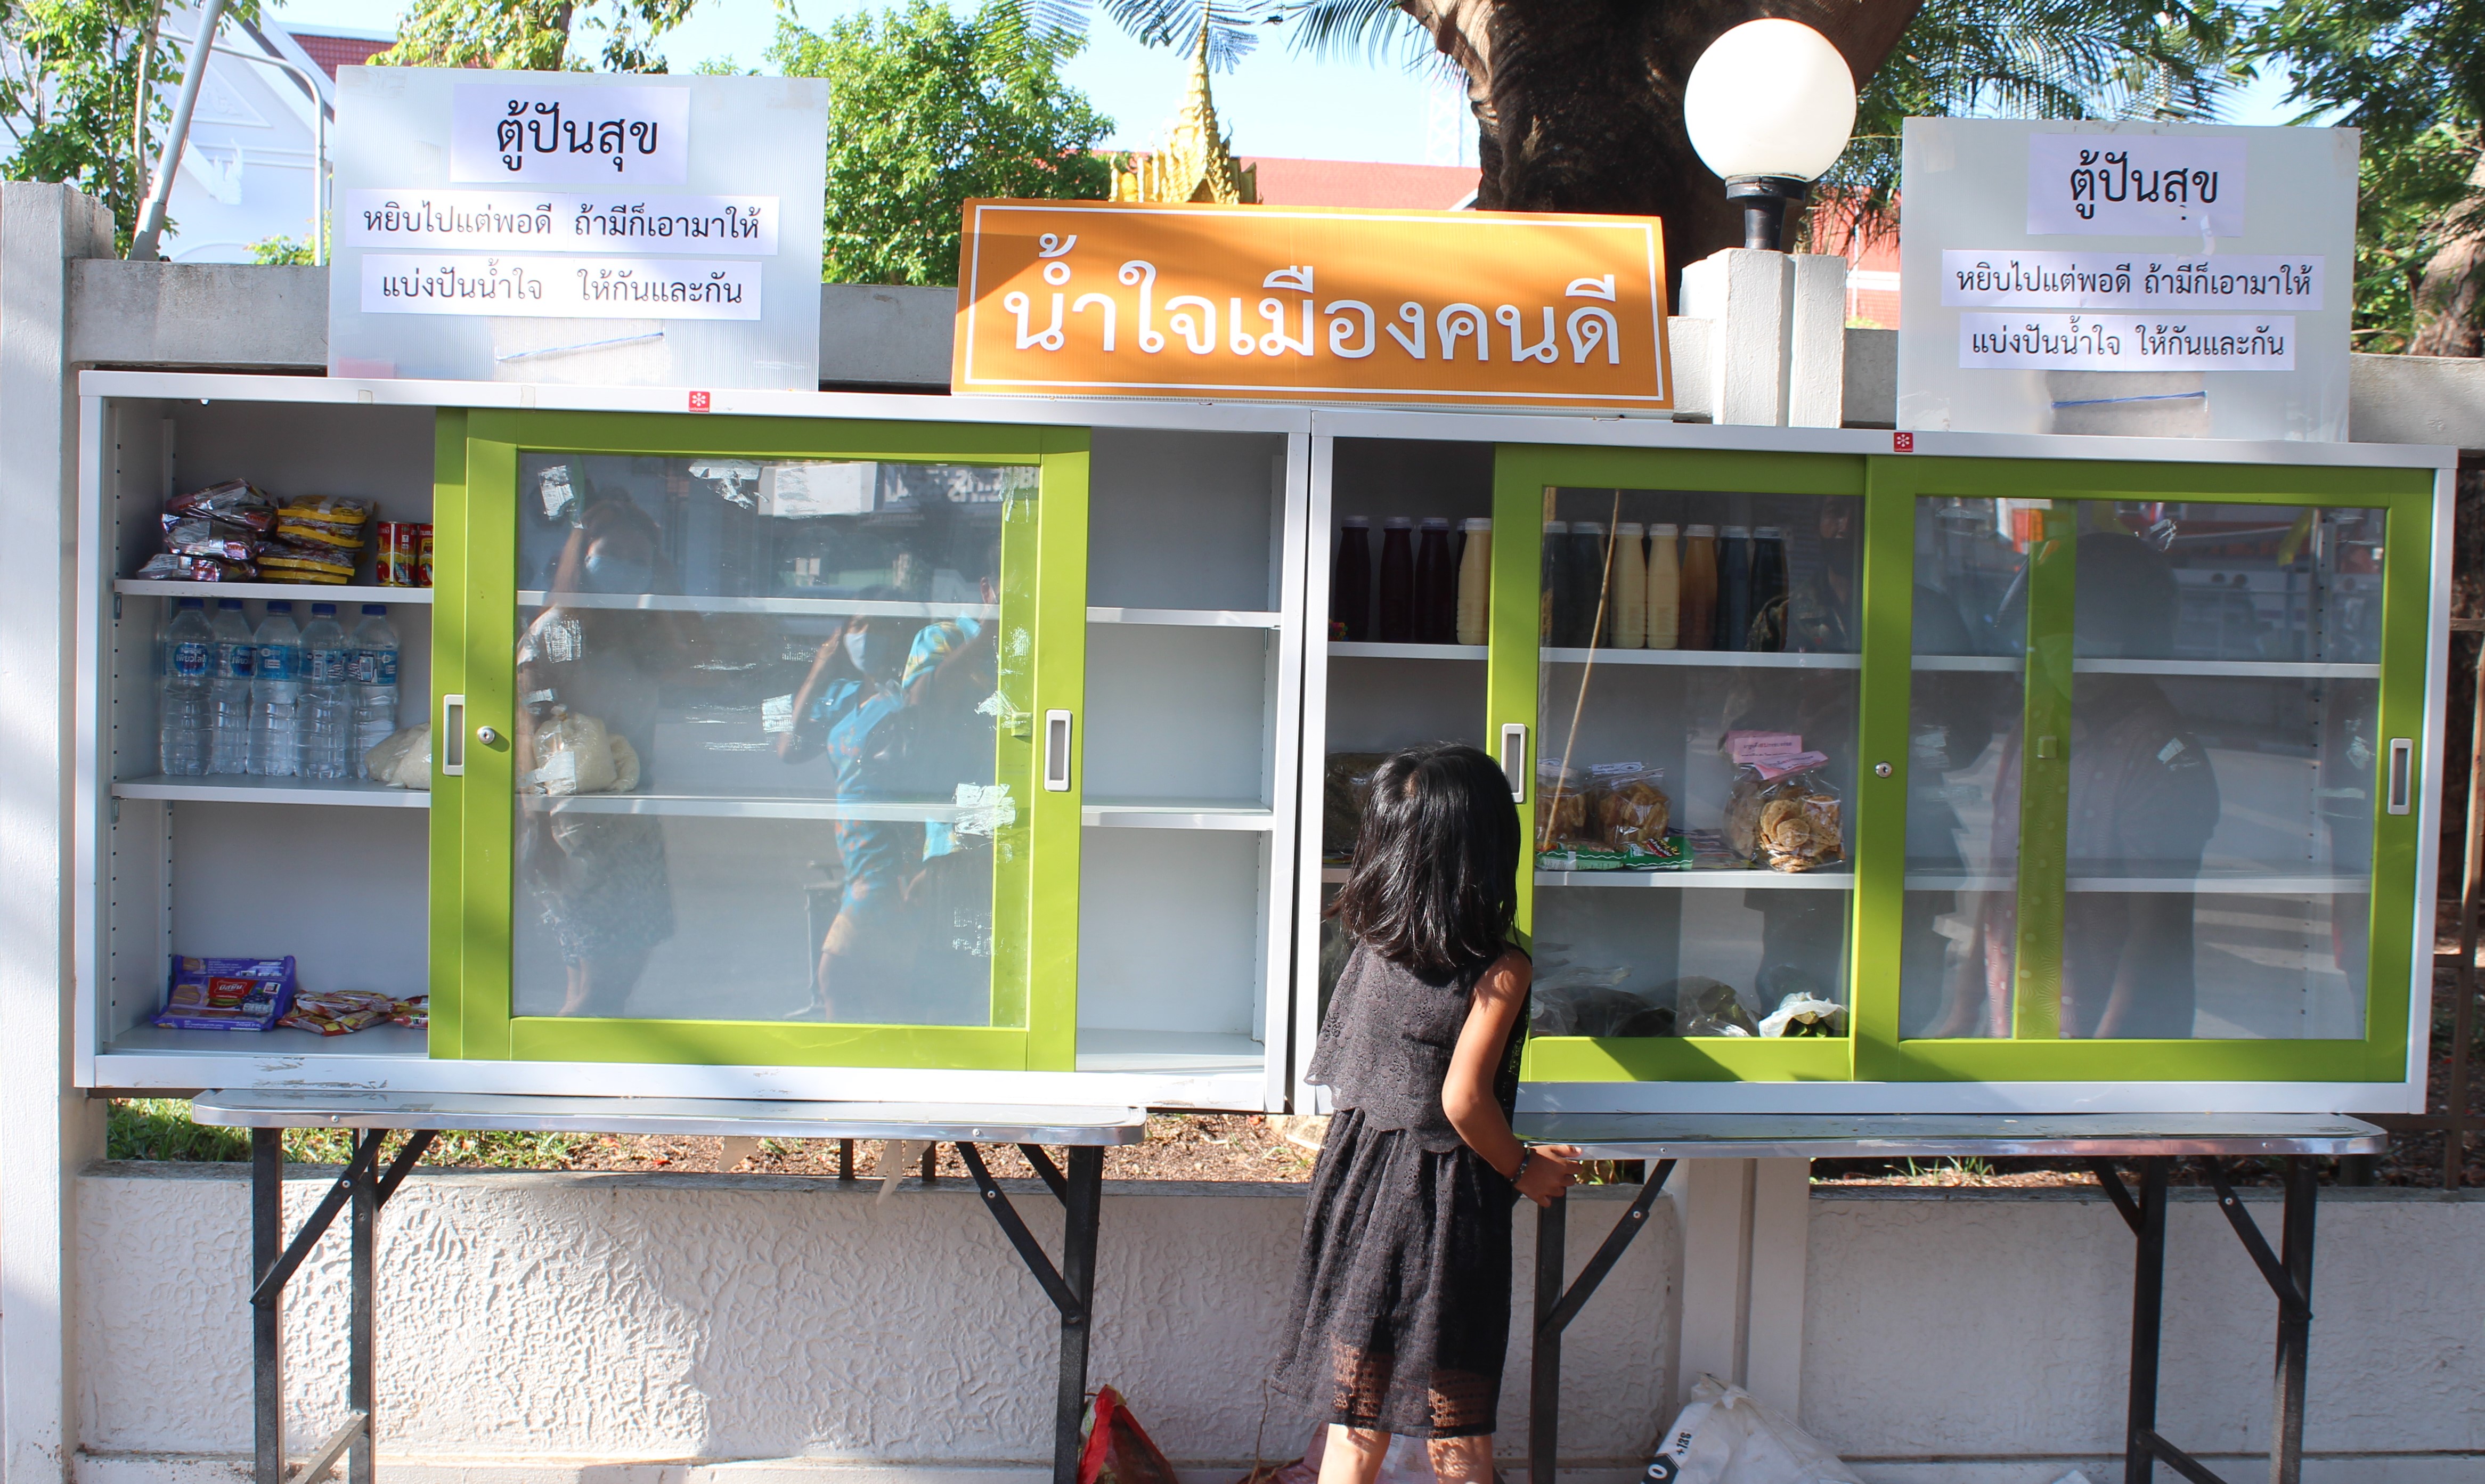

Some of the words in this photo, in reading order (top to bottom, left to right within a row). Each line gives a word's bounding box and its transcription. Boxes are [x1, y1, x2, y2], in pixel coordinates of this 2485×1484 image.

[497, 99, 658, 173] ตู้ปันสุข
[2070, 149, 2218, 221] ตู้ปันสุข
[363, 200, 552, 234] หยิบไปแต่พอดี
[575, 202, 761, 239] ถ้ามีก็เอามาให้
[382, 258, 542, 300] แบ่งปันน้ำใจ
[577, 268, 743, 304] ให้กันและกัน
[1003, 232, 1620, 364] น้ำใจเมืองคนดี
[1956, 259, 2131, 294] หยิบไปแต่พอดี
[2144, 262, 2312, 296] ถ้ามีก็เอามาให้
[1972, 315, 2120, 356] แบ่งปันน้ำใจ
[2135, 324, 2284, 356] ให้กันและกัน
